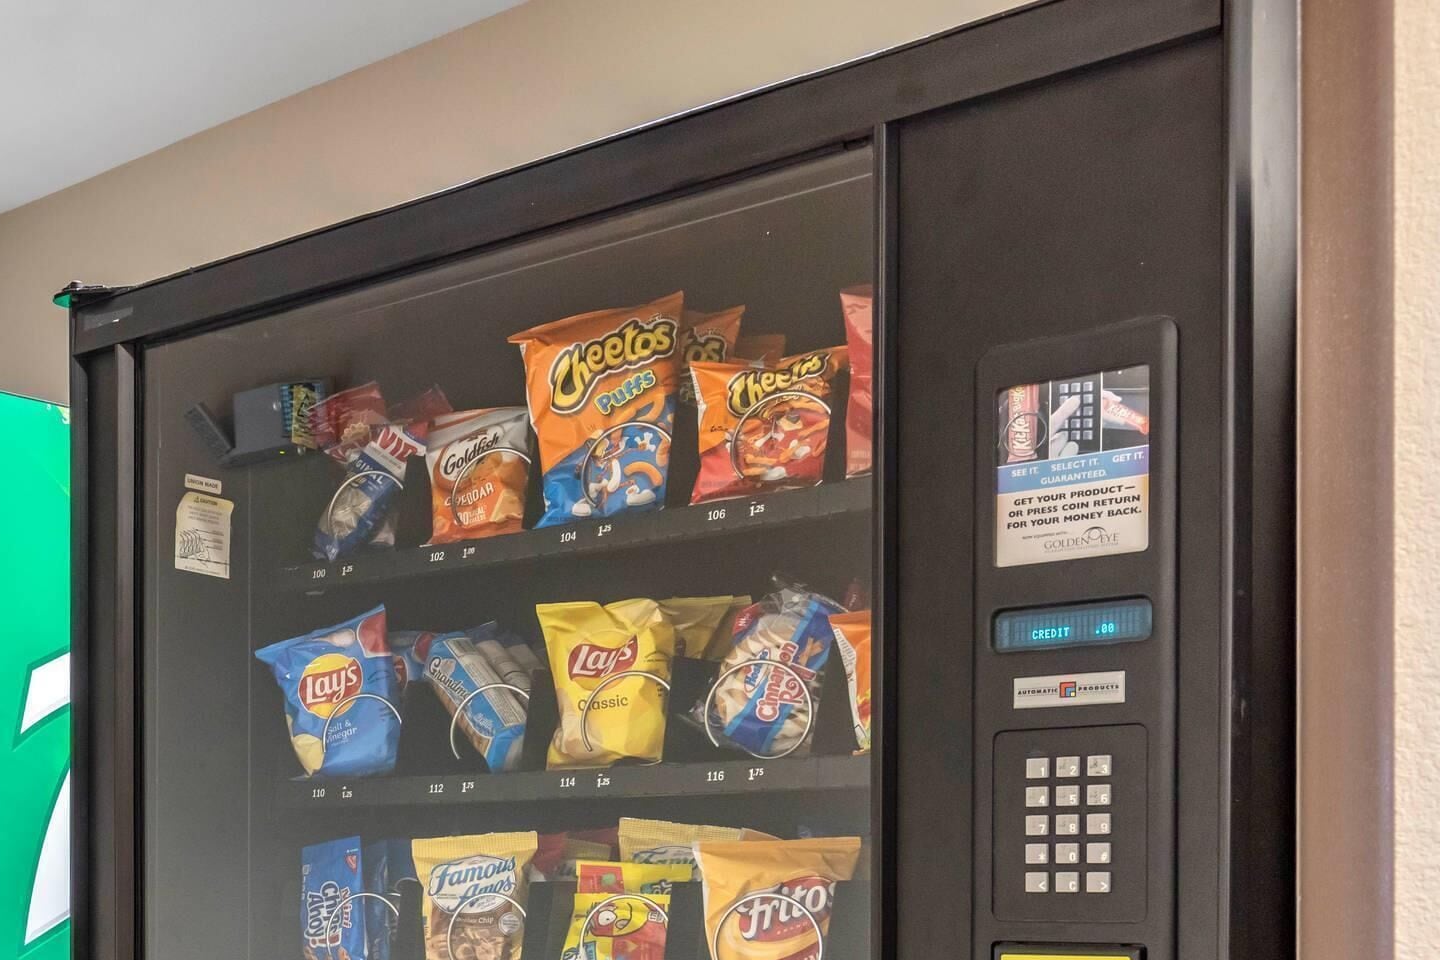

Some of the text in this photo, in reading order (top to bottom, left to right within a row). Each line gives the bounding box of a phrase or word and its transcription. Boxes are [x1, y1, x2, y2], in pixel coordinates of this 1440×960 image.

[552, 319, 678, 410] Cheetos
[728, 352, 831, 417] Cheetos
[595, 369, 657, 414] Puffs
[443, 432, 499, 475] Goldfish
[1011, 468, 1028, 478] SEE
[1051, 460, 1085, 472] SELECT
[1089, 458, 1100, 466] IT.
[1112, 453, 1131, 463] GET
[1134, 451, 1145, 459] IT.
[1040, 469, 1107, 485] GUARANTEED.
[1014, 497, 1034, 506] GET
[1037, 492, 1066, 503] YOUR
[1009, 494, 1141, 518] OR PRESS COIN RETURN
[708, 509, 726, 521] 106
[1007, 506, 1142, 530] FOR YOUR MONEY BACK.
[560, 531, 576, 542] 104
[1044, 537, 1089, 550] GOLDEN
[1101, 532, 1120, 545] EYE
[430, 551, 444, 562] 102
[312, 569, 326, 579] 100
[1032, 623, 1115, 640] CREDIT .00
[572, 637, 637, 677] Lay's
[305, 663, 360, 704] Lay's
[1017, 684, 1119, 696] AUTOMATIC PRODUCTS
[1041, 767, 1045, 776] 1
[1070, 766, 1077, 776] 2
[1101, 764, 1108, 774] 3
[707, 771, 724, 782] 116
[429, 783, 444, 793] 112
[560, 778, 575, 788] 114
[312, 788, 325, 798] 110
[1101, 793, 1108, 803] 6
[1038, 796, 1045, 805] 4
[1070, 794, 1076, 804] 5
[1039, 824, 1045, 834] 7
[1069, 823, 1076, 833] 8
[1101, 823, 1108, 833] 9
[1069, 852, 1076, 862] 0
[432, 855, 517, 894] Famous
[1069, 881, 1076, 891] C
[448, 876, 516, 912] Amos
